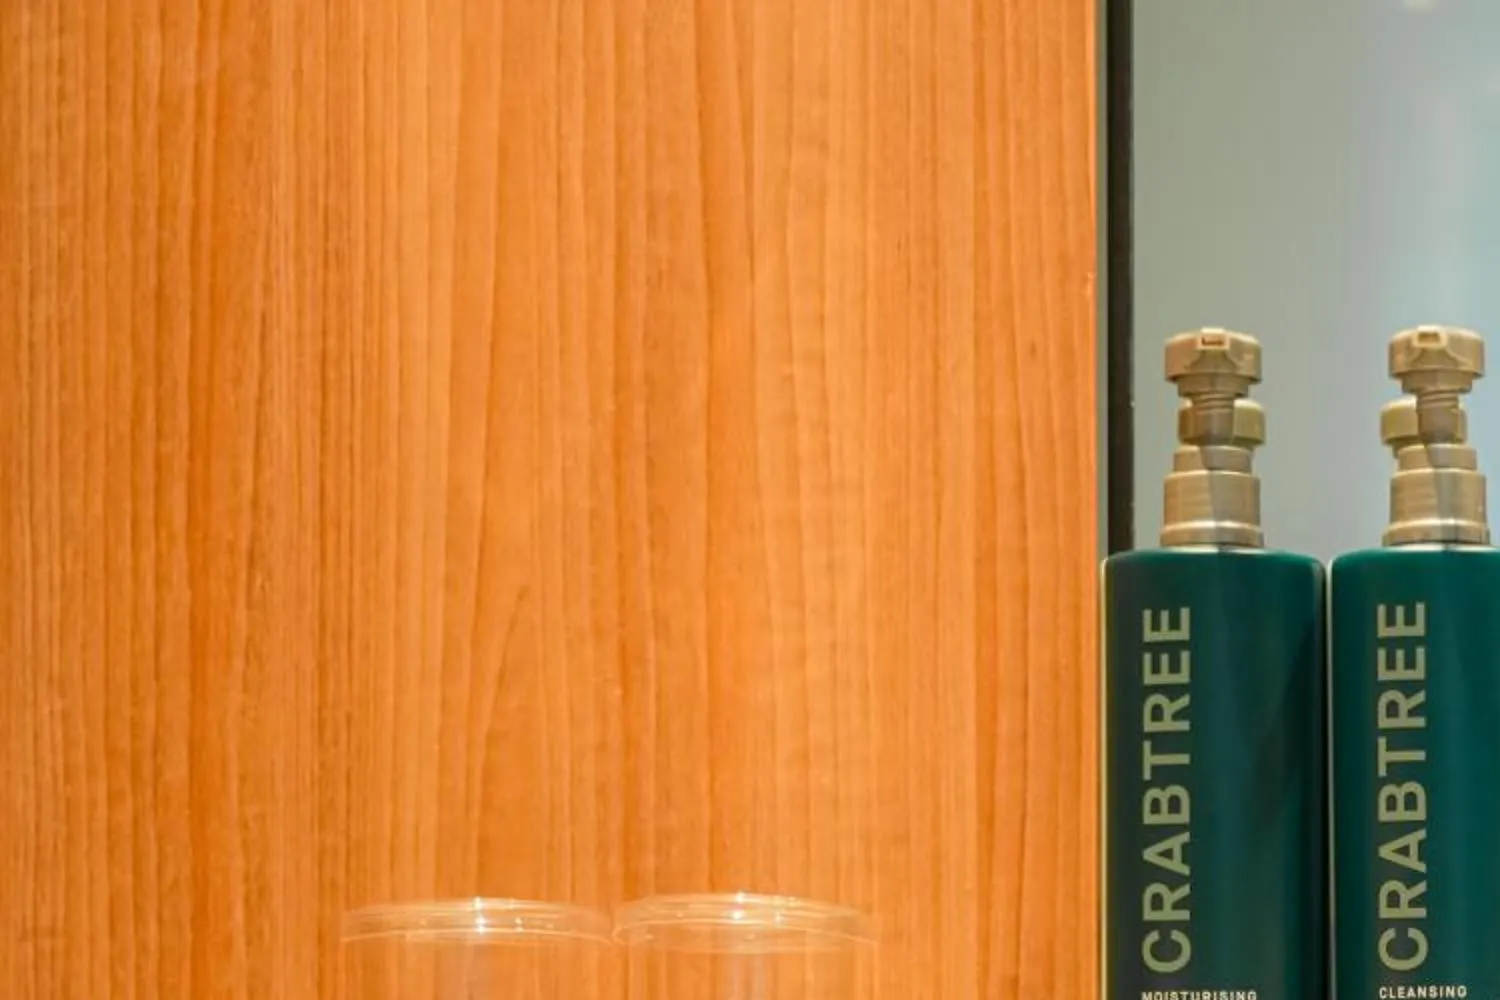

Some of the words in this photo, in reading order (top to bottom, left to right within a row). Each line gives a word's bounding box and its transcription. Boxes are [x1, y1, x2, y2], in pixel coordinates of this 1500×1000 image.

[1142, 607, 1192, 973] CRABTREE
[1377, 602, 1428, 972] CRABTREE
[1379, 985, 1467, 999] CLEANSING
